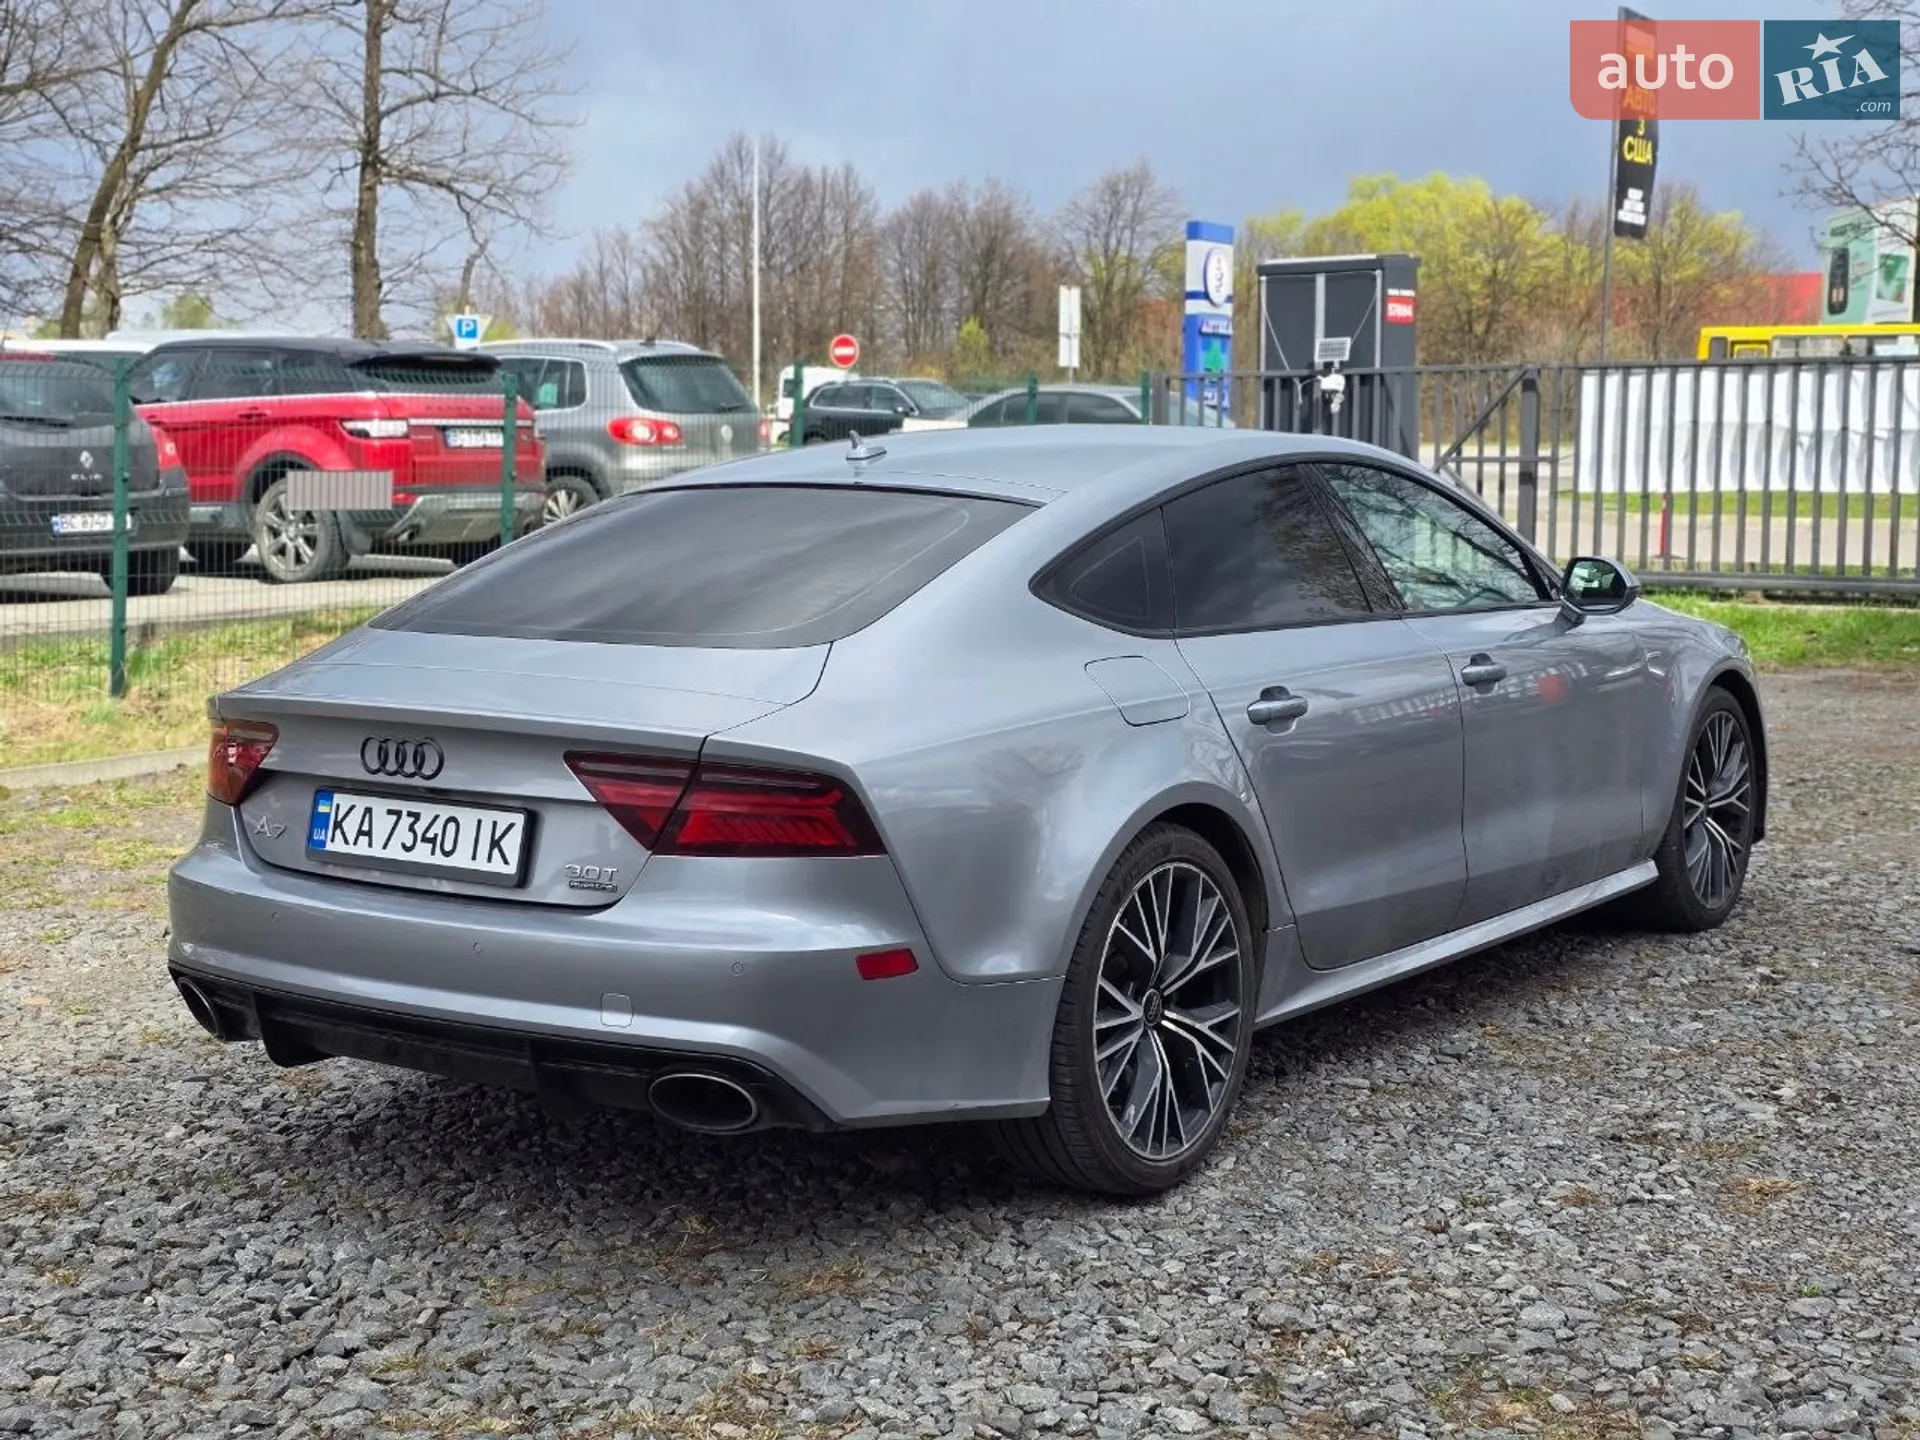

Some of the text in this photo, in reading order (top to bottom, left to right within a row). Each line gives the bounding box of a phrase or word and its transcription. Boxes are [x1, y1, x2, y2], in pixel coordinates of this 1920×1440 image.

[1623, 135, 1653, 165] США
[461, 320, 474, 337] P
[253, 815, 287, 839] A7
[313, 827, 326, 841] UA
